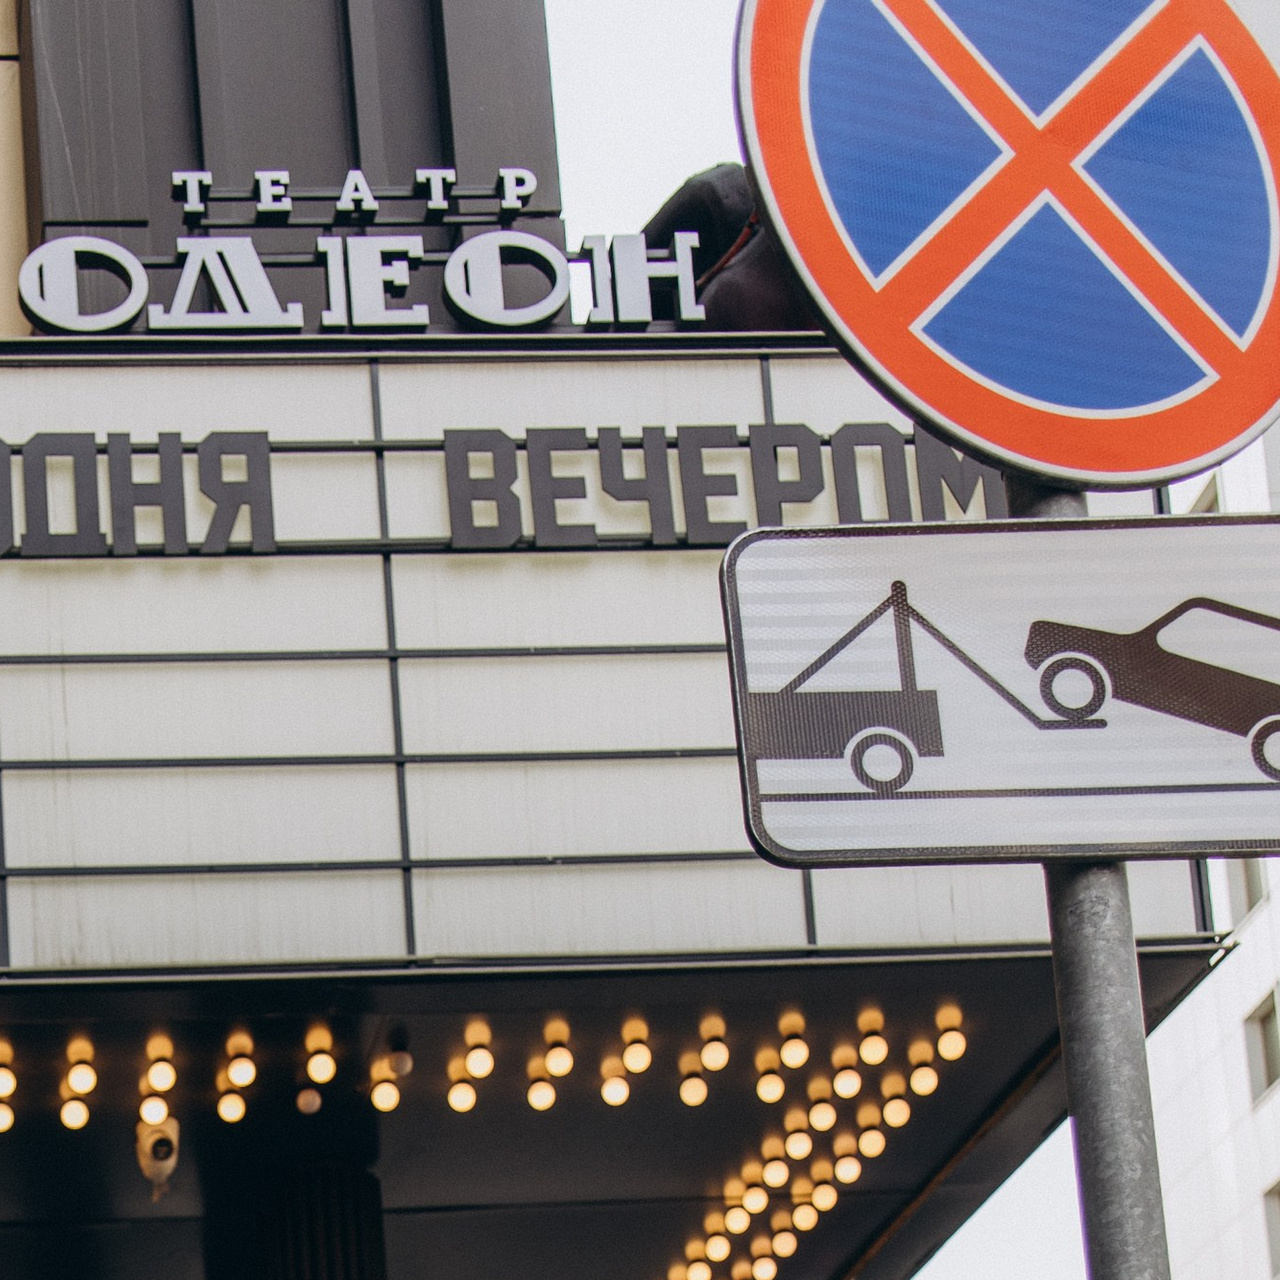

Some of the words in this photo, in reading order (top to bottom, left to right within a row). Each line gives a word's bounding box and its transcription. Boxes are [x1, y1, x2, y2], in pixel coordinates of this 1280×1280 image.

[171, 167, 538, 220] ТЕАТР
[18, 230, 706, 334] ОДЕОН
[443, 422, 1008, 549] ВЕЧЕРОМ
